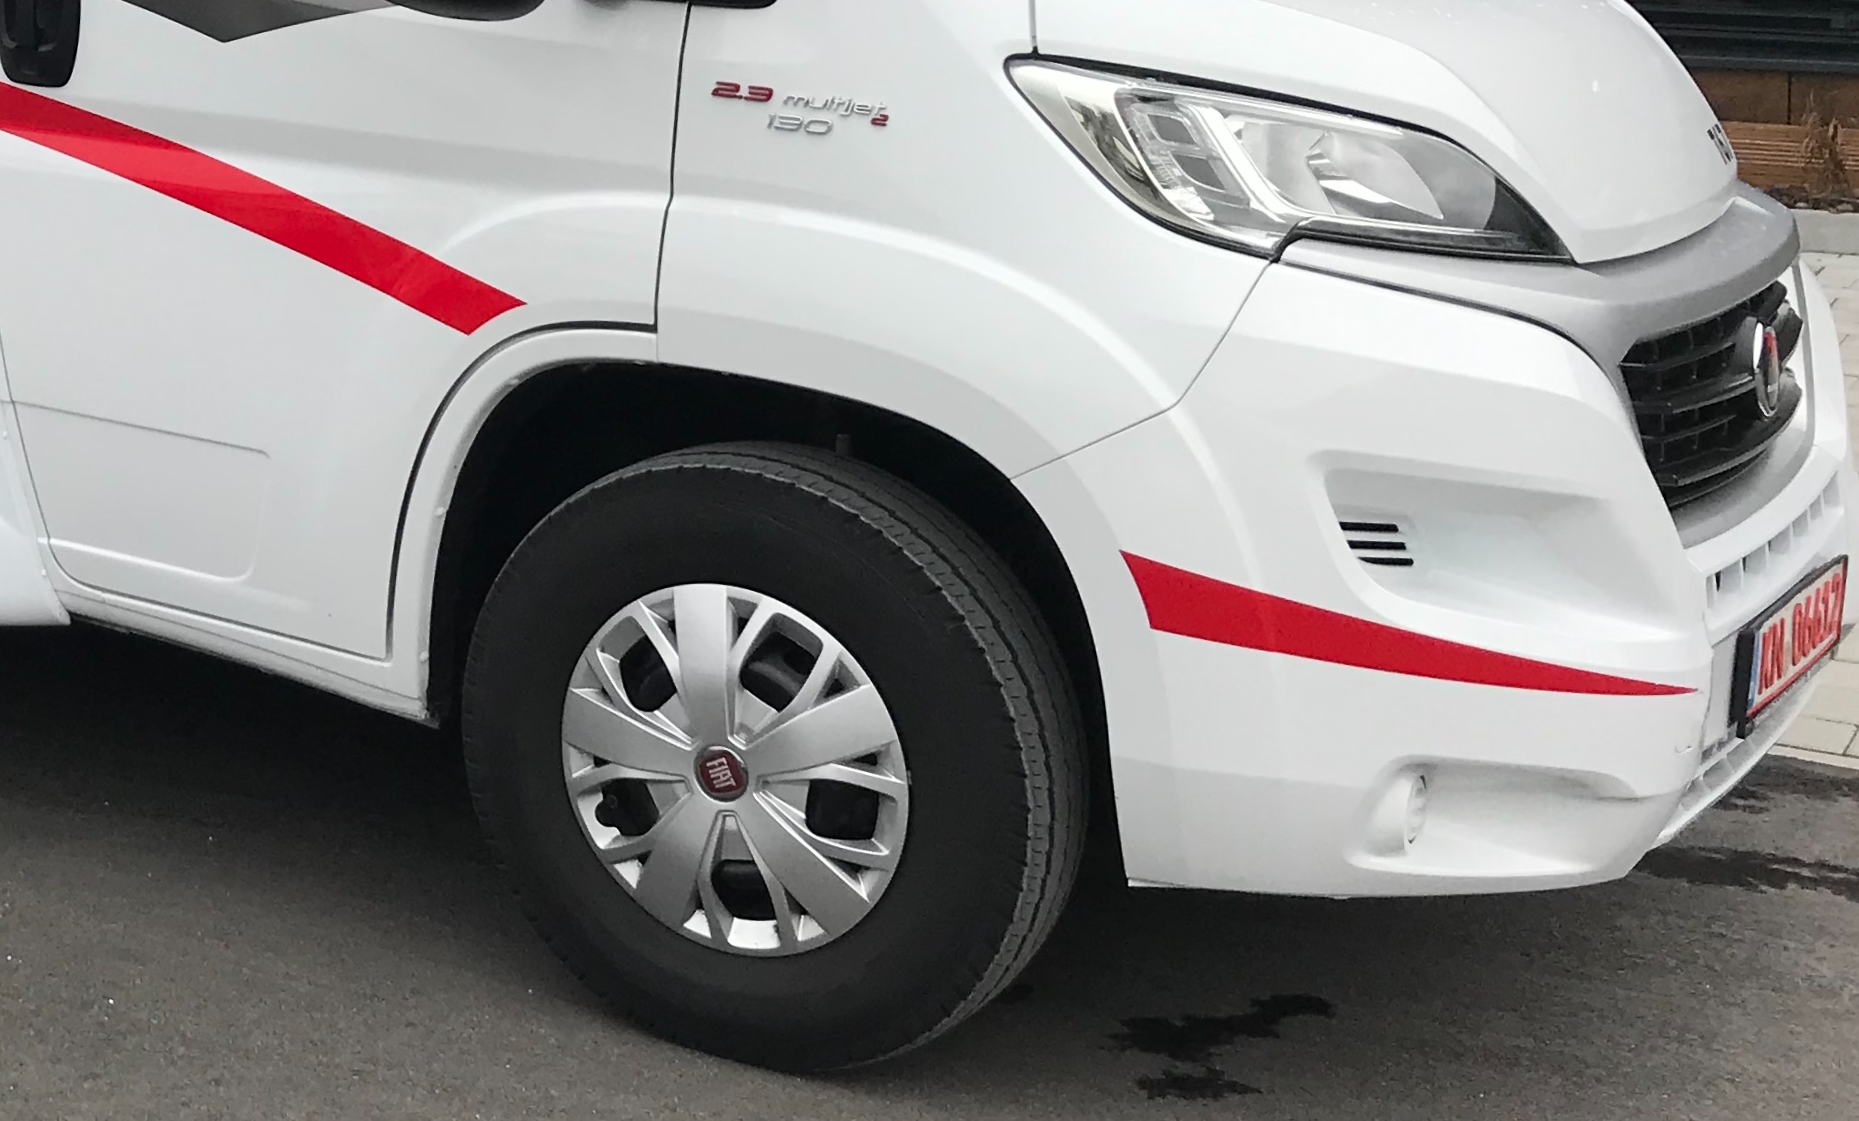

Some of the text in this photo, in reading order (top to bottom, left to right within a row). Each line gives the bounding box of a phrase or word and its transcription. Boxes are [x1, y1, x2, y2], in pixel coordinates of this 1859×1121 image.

[711, 81, 774, 103] 2.3
[766, 112, 834, 136] 130
[1758, 617, 1785, 696] KN
[706, 757, 737, 789] FIAT
